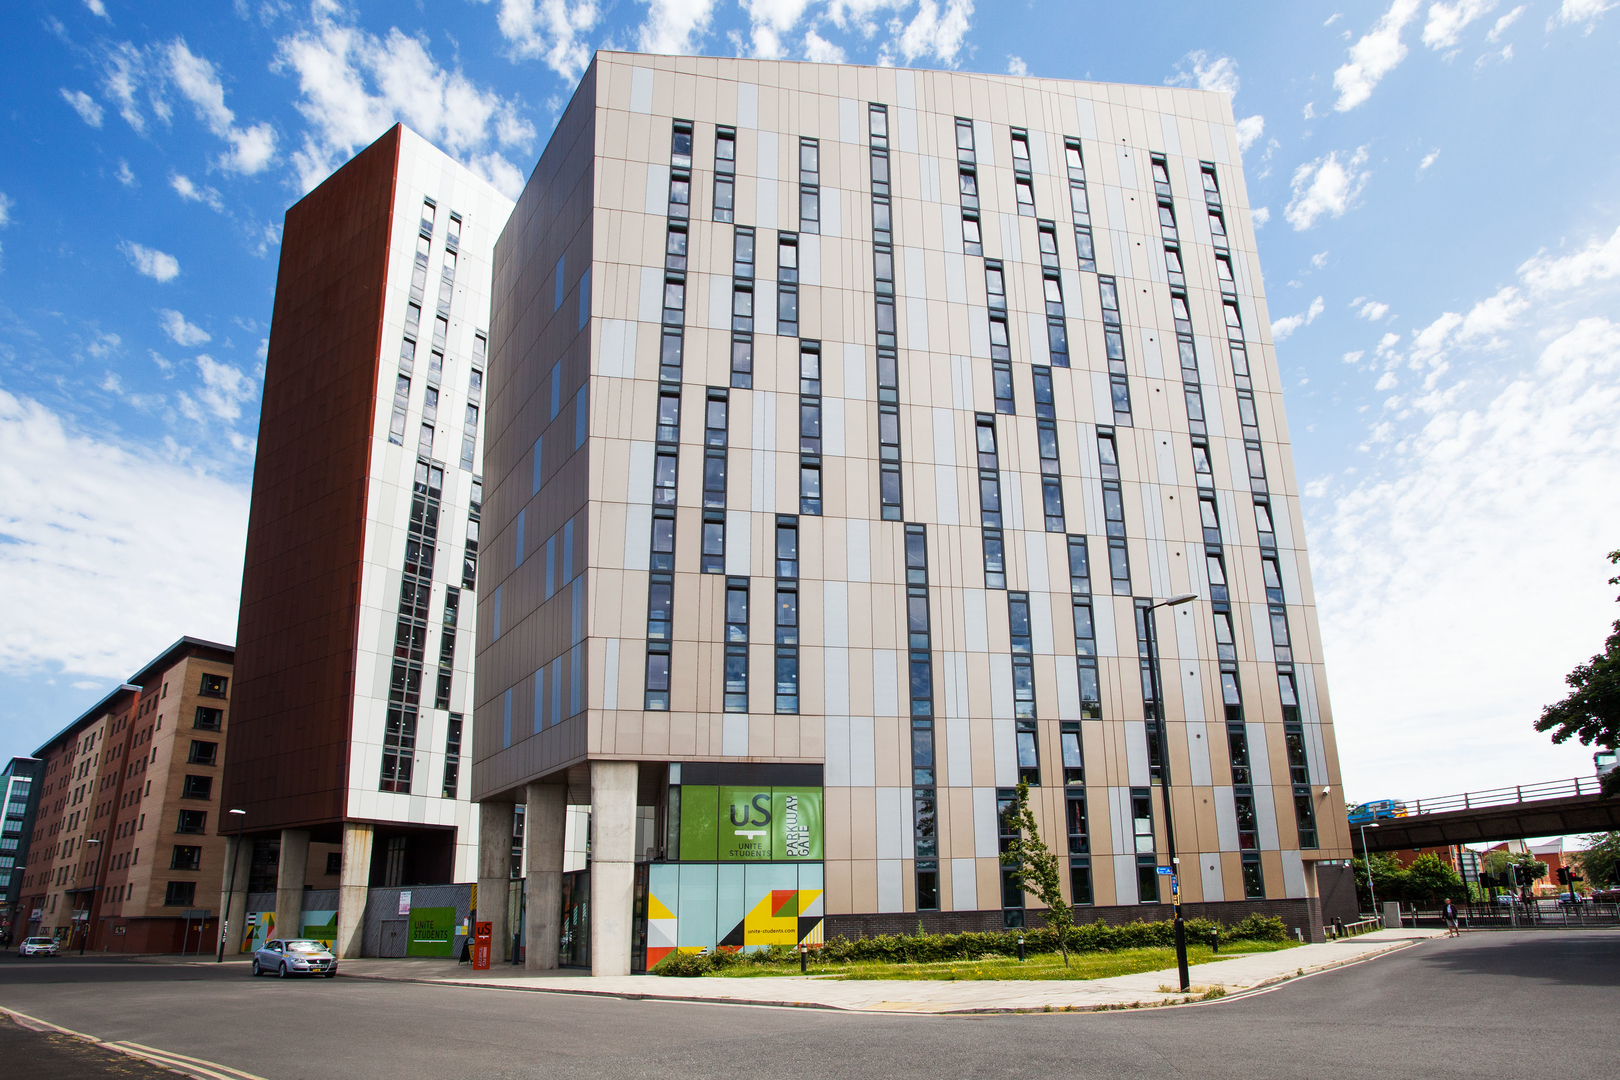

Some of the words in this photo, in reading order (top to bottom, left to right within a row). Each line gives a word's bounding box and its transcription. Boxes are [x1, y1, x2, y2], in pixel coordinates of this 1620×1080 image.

[786, 795, 798, 857] PARKWAY
[798, 825, 809, 857] GATE
[414, 920, 434, 929] UNITE
[414, 930, 448, 939] STUDENTS
